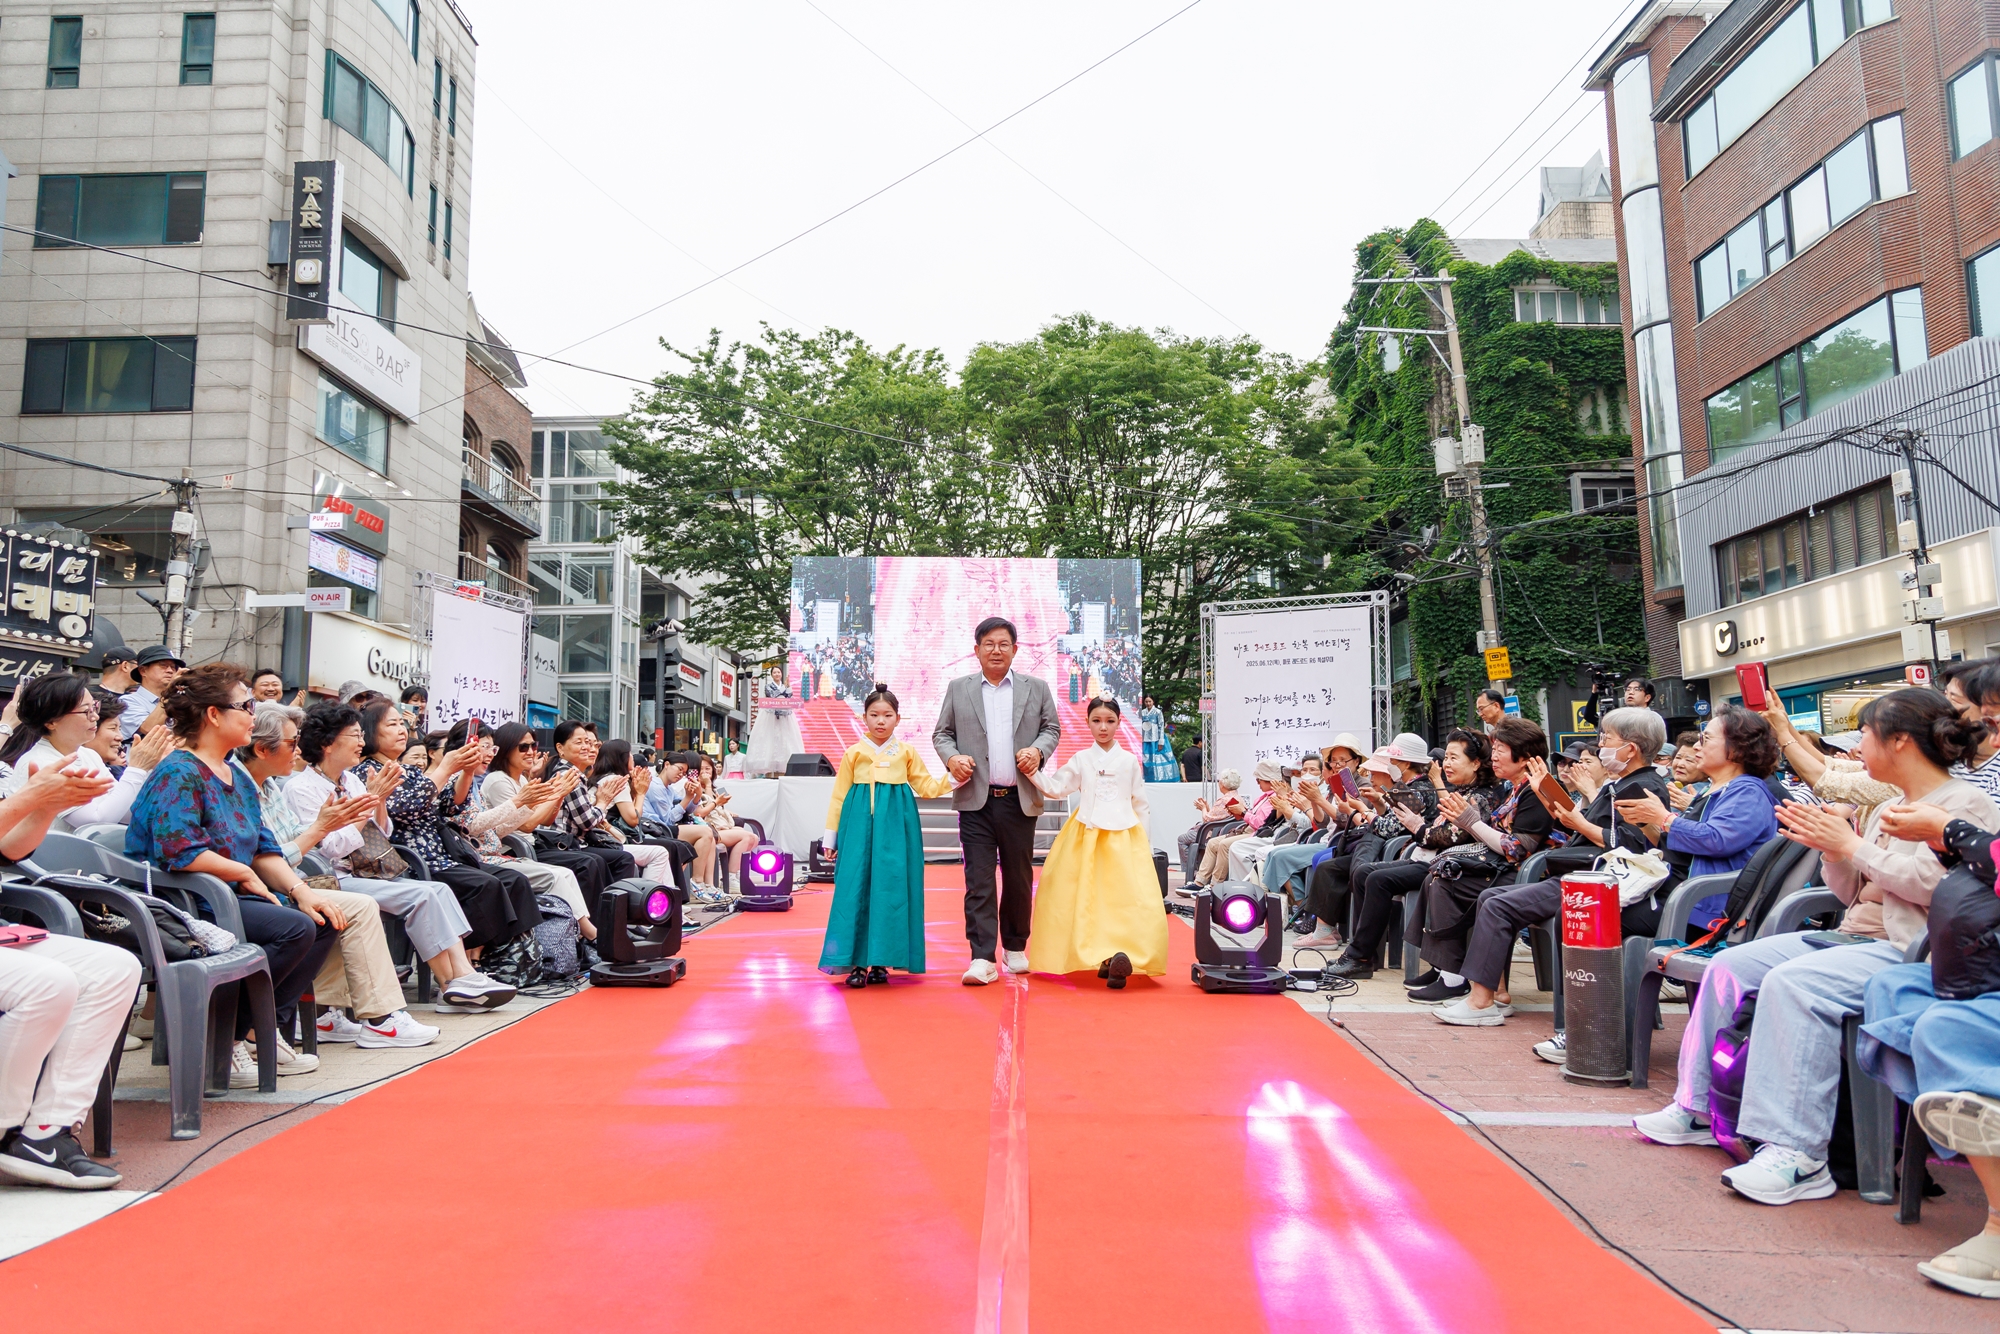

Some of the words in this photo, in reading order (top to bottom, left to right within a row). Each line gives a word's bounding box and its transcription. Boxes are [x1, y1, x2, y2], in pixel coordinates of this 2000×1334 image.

[299, 176, 322, 229] BAR
[376, 345, 404, 382] BAR
[322, 494, 354, 515] ASAP
[354, 508, 385, 534] PIZZA
[310, 593, 324, 601] ON
[325, 593, 341, 601] AIR
[1233, 643, 1249, 658] 마포
[1254, 642, 1287, 652] 레드로드
[1292, 639, 1309, 651] 한복
[1314, 638, 1350, 651] 페스티벌
[1740, 636, 1765, 649] SHOP
[1292, 657, 1308, 665] 레드로드
[454, 672, 468, 699] 마포
[473, 677, 501, 694] 레드로드
[1244, 694, 1271, 714] 과거와
[1273, 692, 1299, 707] 현재를
[1302, 693, 1317, 704] 잇는
[1251, 717, 1270, 736] 마포
[1274, 717, 1331, 729] 레드로드에서
[1255, 749, 1269, 762] 우리
[1273, 744, 1301, 761] 한복을
[1565, 968, 1597, 982] MAPO
